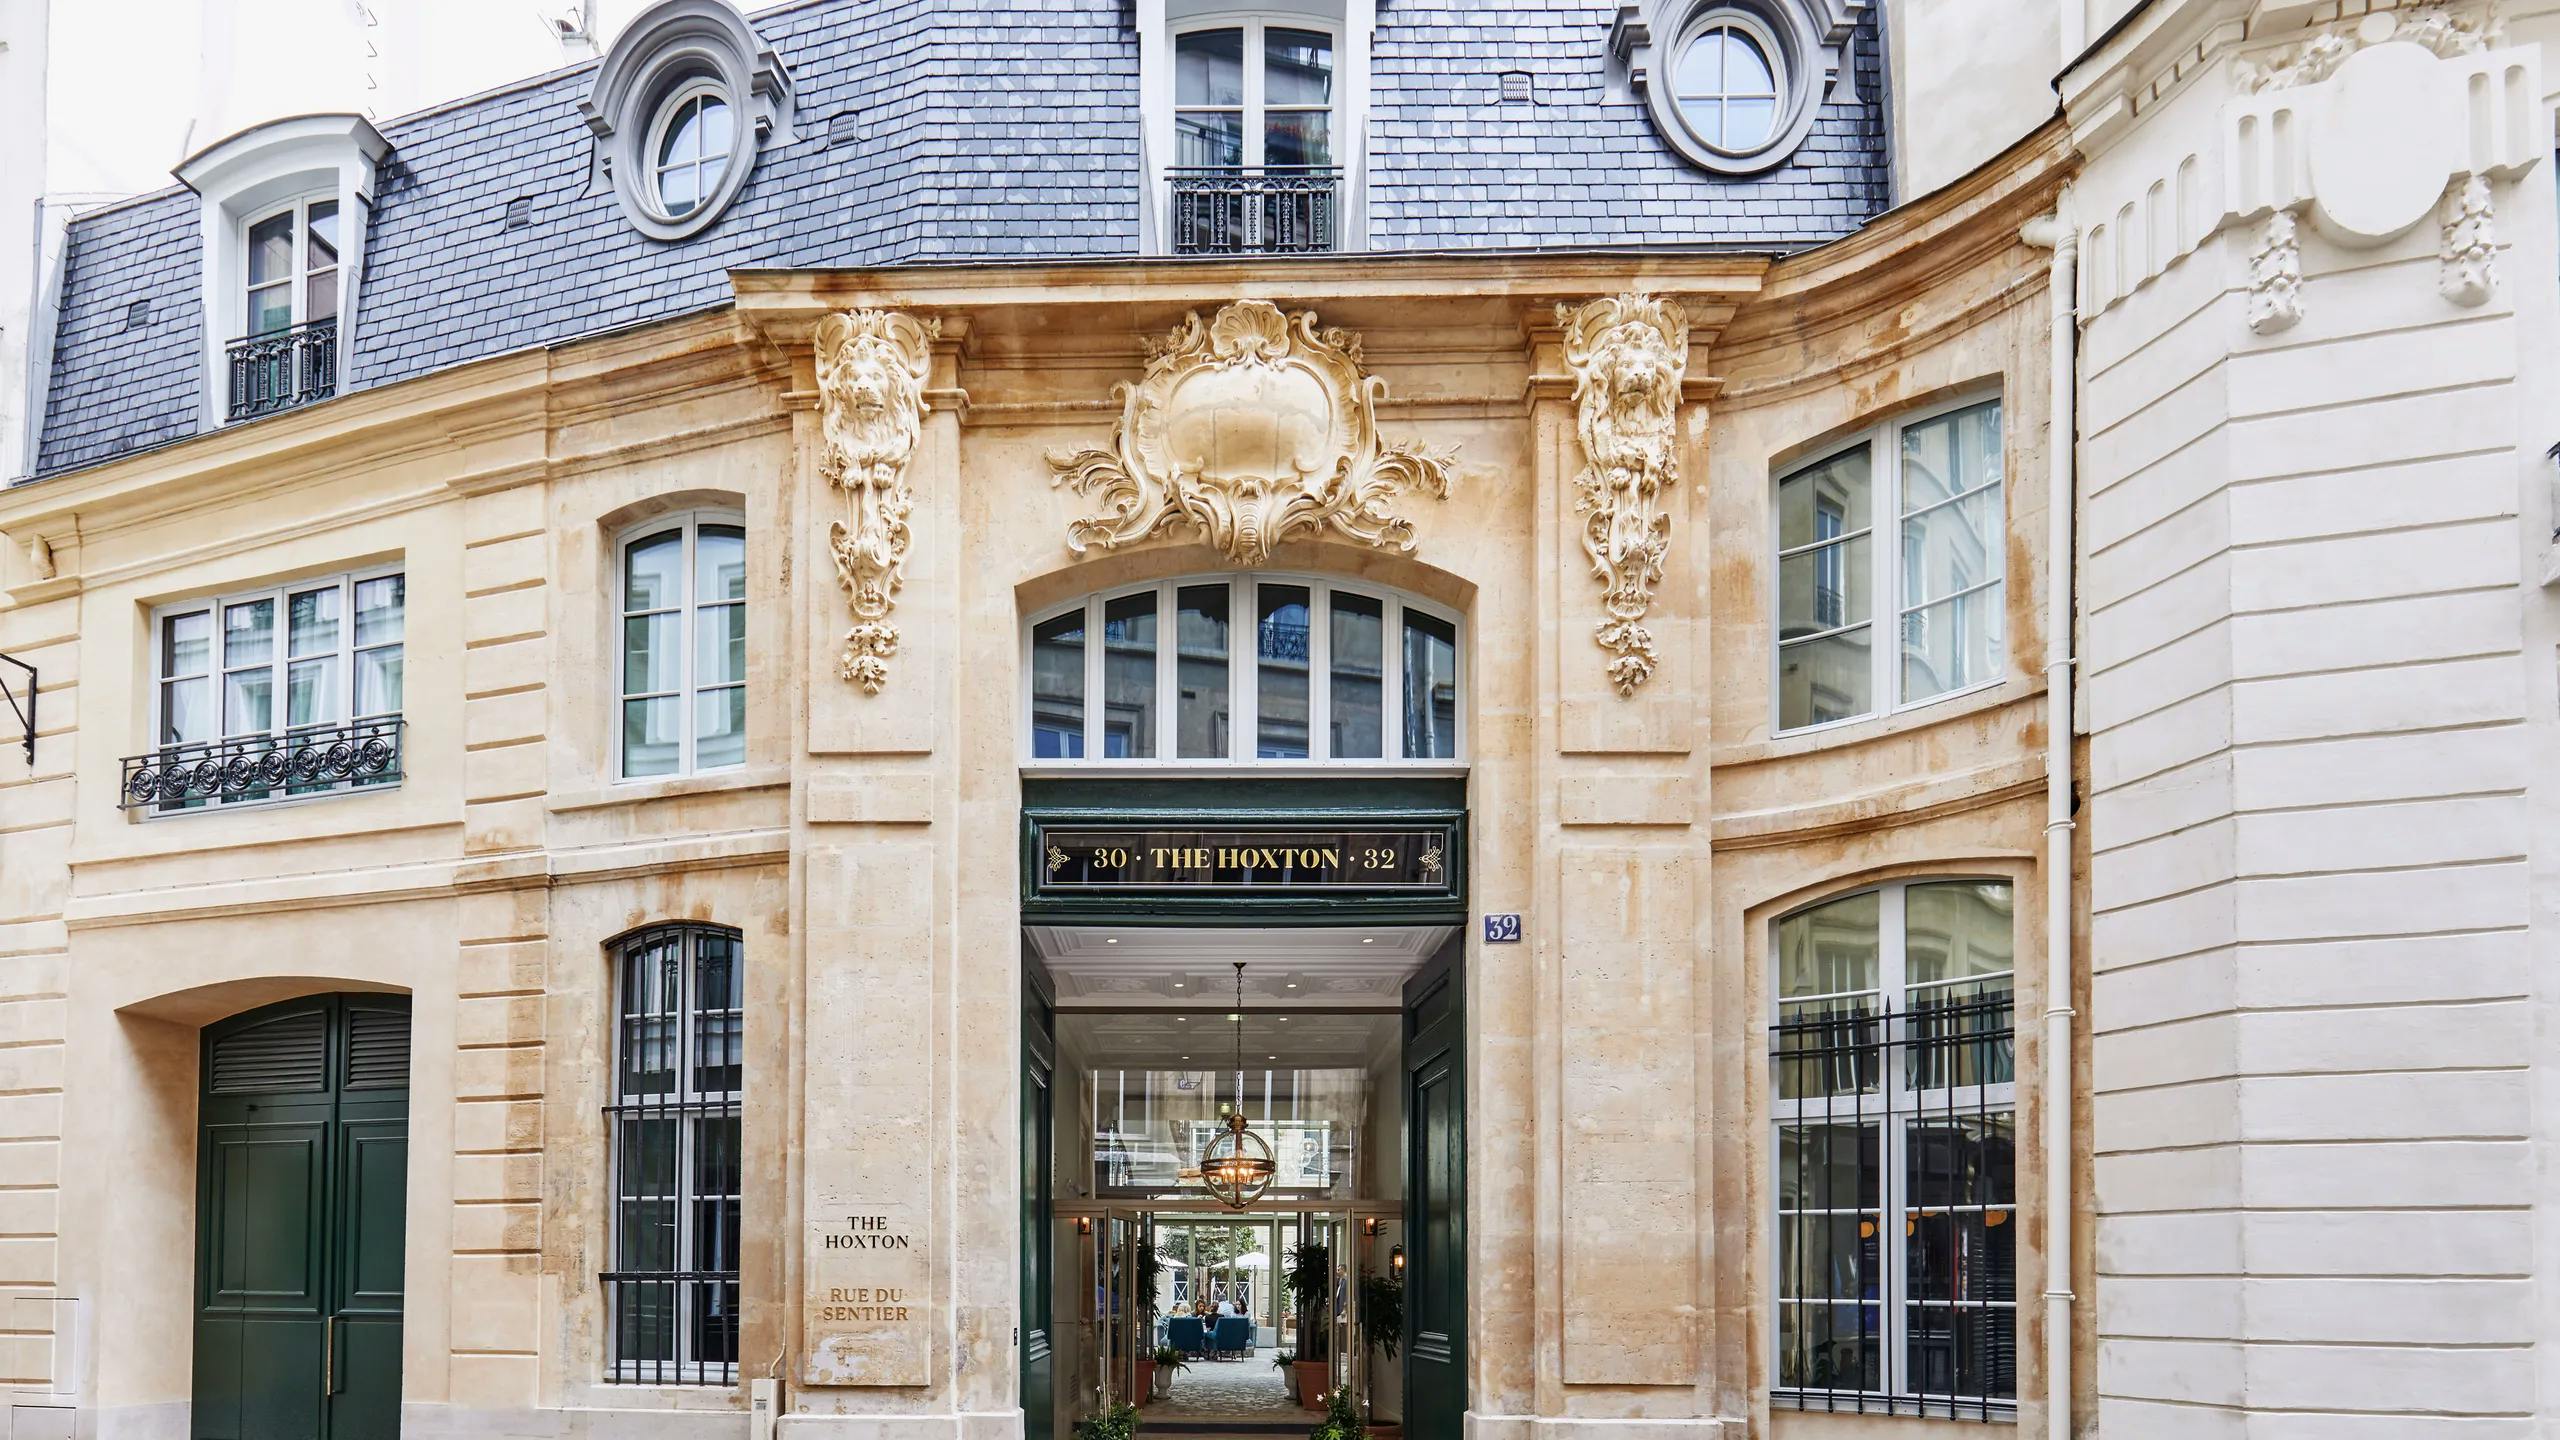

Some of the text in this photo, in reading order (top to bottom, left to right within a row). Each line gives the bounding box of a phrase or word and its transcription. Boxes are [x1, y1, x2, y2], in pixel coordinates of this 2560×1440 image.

[1094, 848, 1395, 869] 30 THE HOXTON 32
[1489, 915, 1518, 940] 32
[847, 1216, 888, 1231] THE
[825, 1235, 909, 1249] HOXTON
[831, 1288, 903, 1303] RUE DU
[823, 1306, 909, 1321] SENTIER
